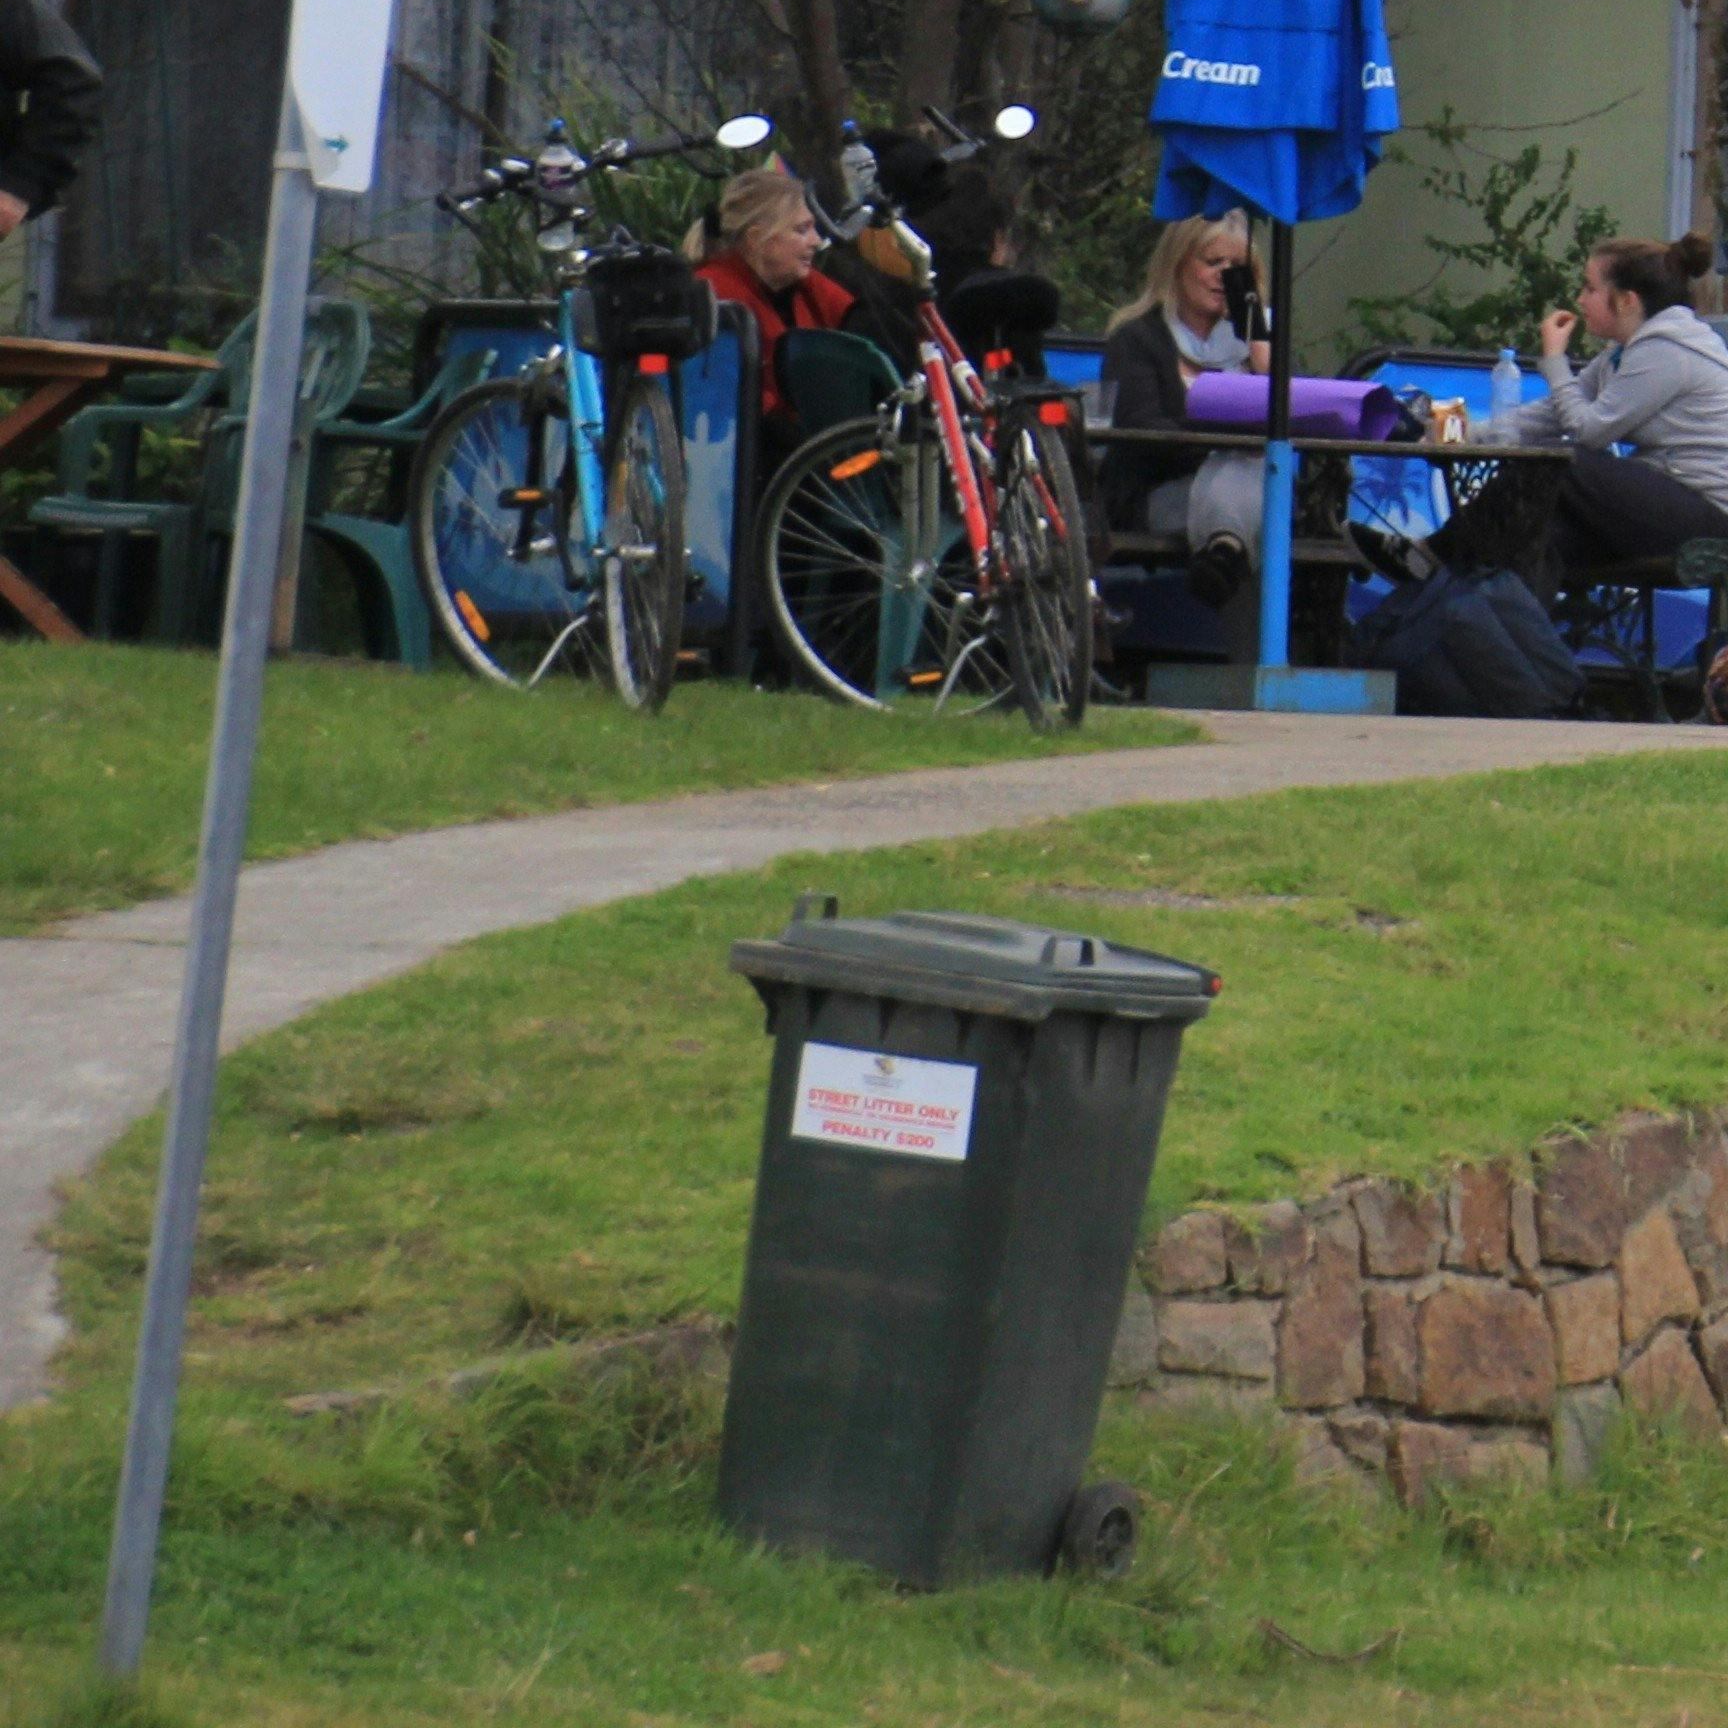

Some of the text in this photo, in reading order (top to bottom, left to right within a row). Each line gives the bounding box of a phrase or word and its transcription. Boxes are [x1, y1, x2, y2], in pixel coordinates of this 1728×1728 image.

[1162, 50, 1261, 87] Cream
[808, 1087, 858, 1107] STREET
[864, 1096, 916, 1116] LITTER
[918, 1104, 961, 1122] ONLY
[821, 1120, 892, 1142] PENALTY
